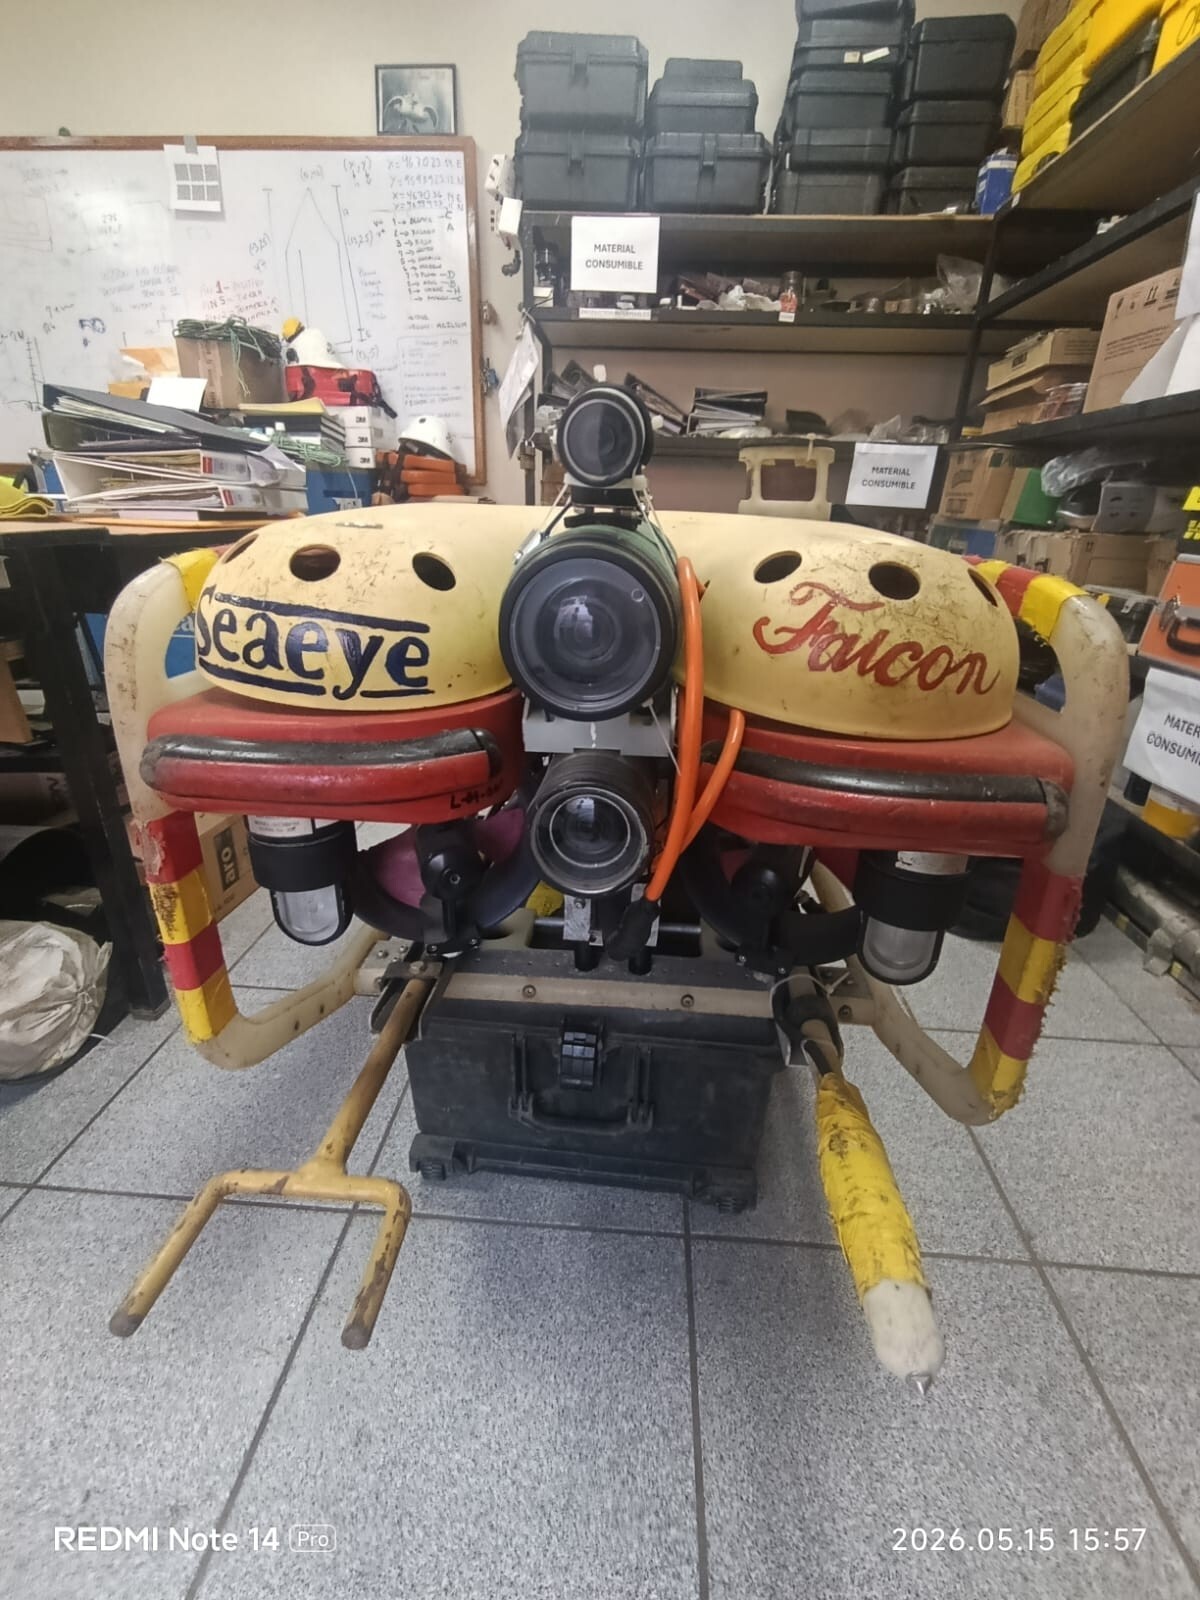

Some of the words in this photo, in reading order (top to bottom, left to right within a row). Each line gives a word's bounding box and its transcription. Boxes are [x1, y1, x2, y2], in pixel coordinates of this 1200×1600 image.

[593, 243, 636, 254] MATERIAL
[585, 259, 644, 271] CONSUMIBLE
[871, 465, 911, 476] MATERIAL
[861, 479, 916, 490] CONSUMIBLE
[195, 584, 430, 701] Seaeye
[752, 581, 1001, 696] Falcon
[1146, 730, 1200, 767] CONSUMI
